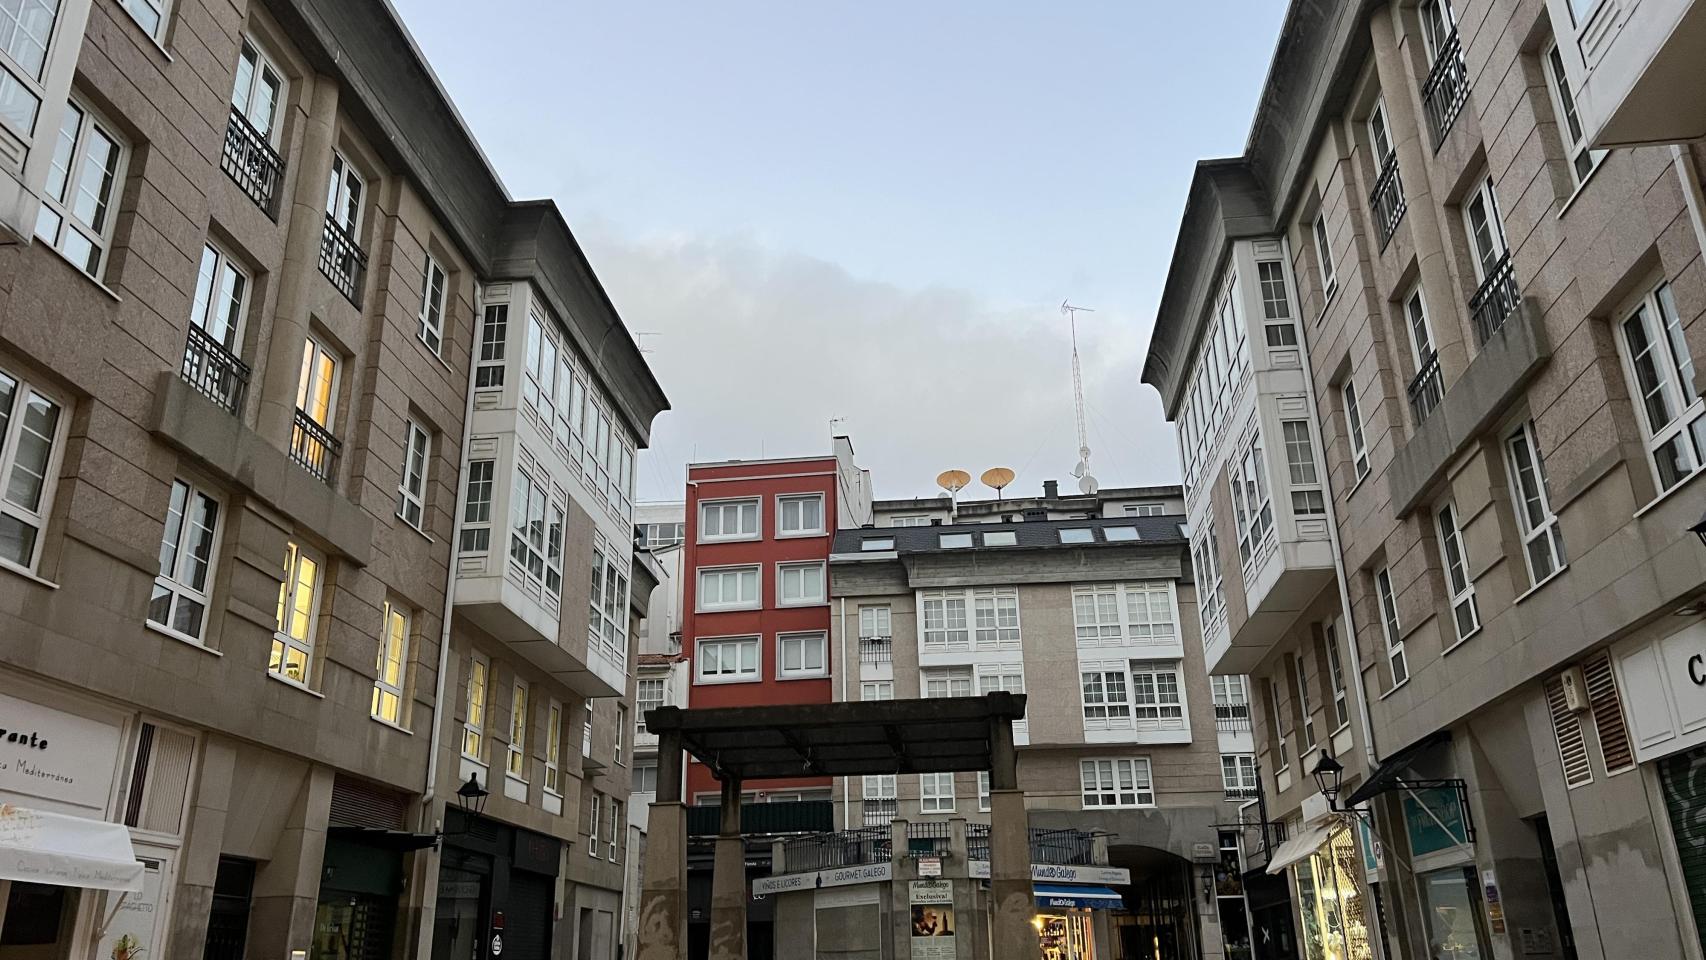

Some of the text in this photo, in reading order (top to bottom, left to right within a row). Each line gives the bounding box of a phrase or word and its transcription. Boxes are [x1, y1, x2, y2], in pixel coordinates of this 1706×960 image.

[834, 866, 886, 881] GOURMET GALEGO
[1057, 866, 1077, 881] Galego
